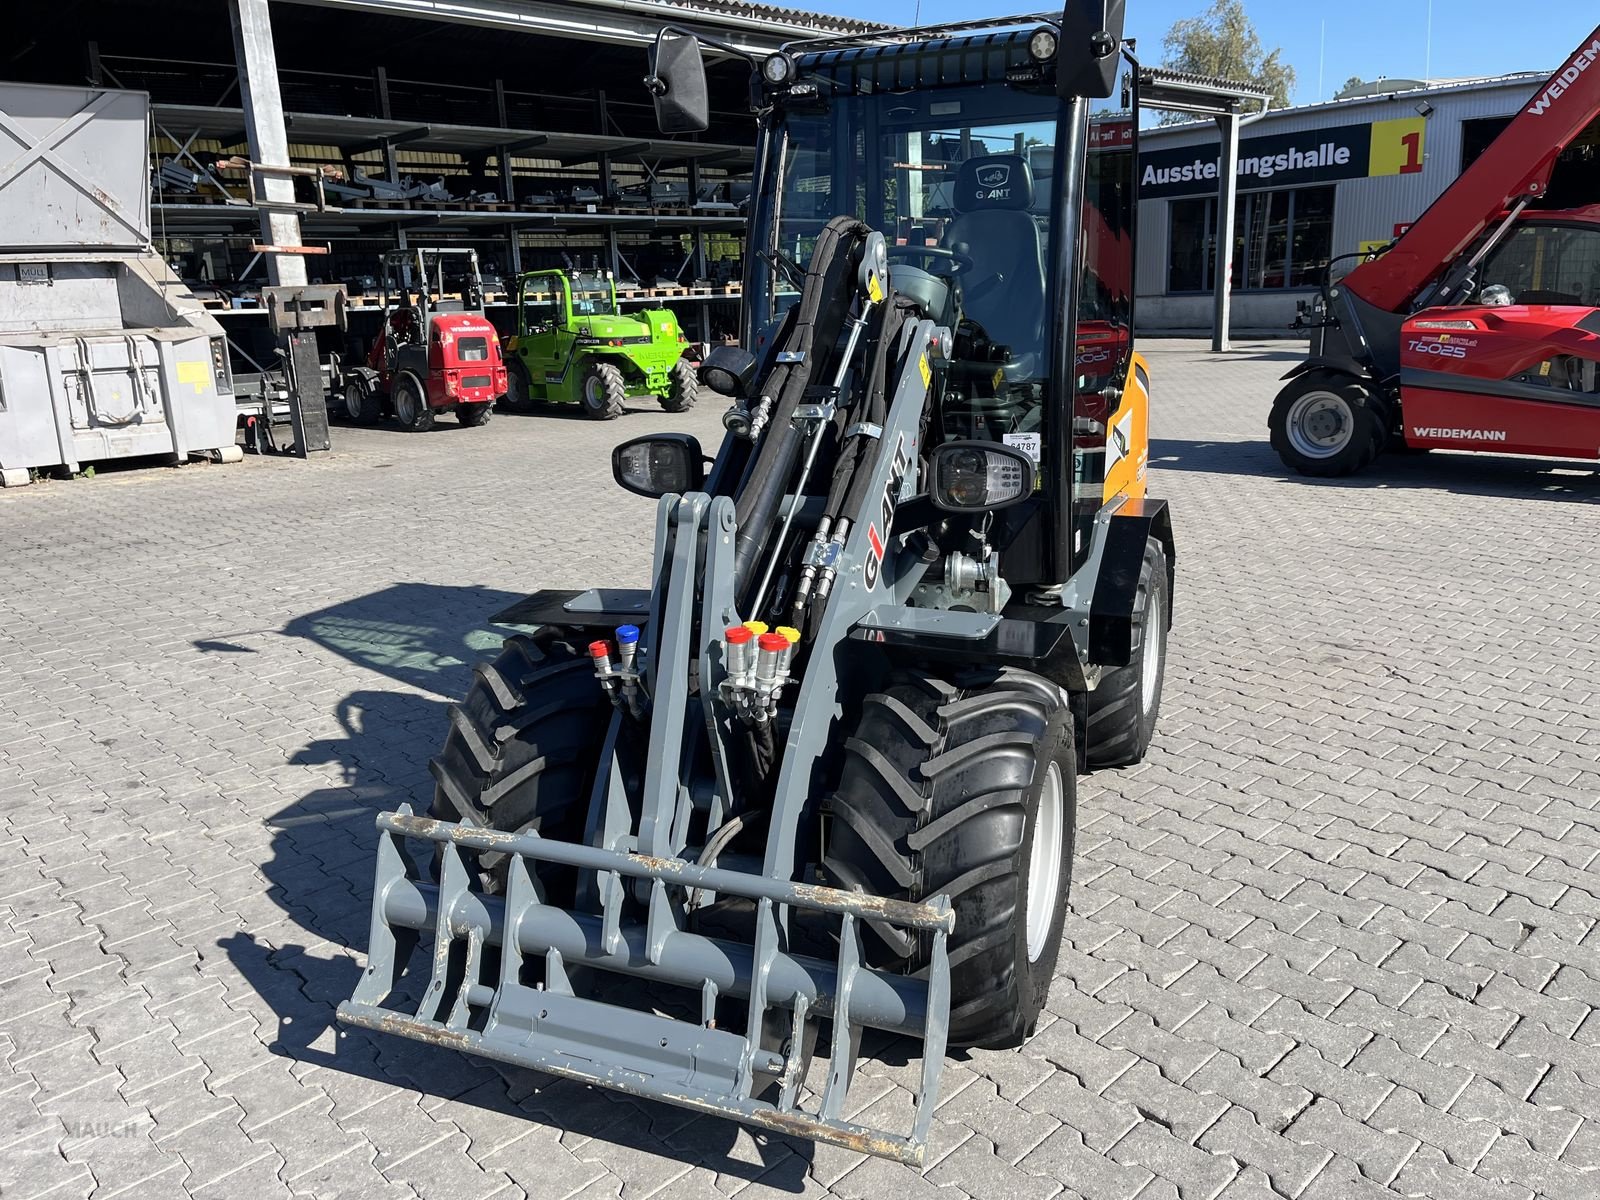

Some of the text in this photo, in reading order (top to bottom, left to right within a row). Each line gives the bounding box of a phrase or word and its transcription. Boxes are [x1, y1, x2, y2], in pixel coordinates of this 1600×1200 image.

[1141, 132, 1422, 186] Ausstelungshalle 1
[1408, 340, 1466, 358] T6025
[1413, 427, 1506, 440] WEIDEMANN
